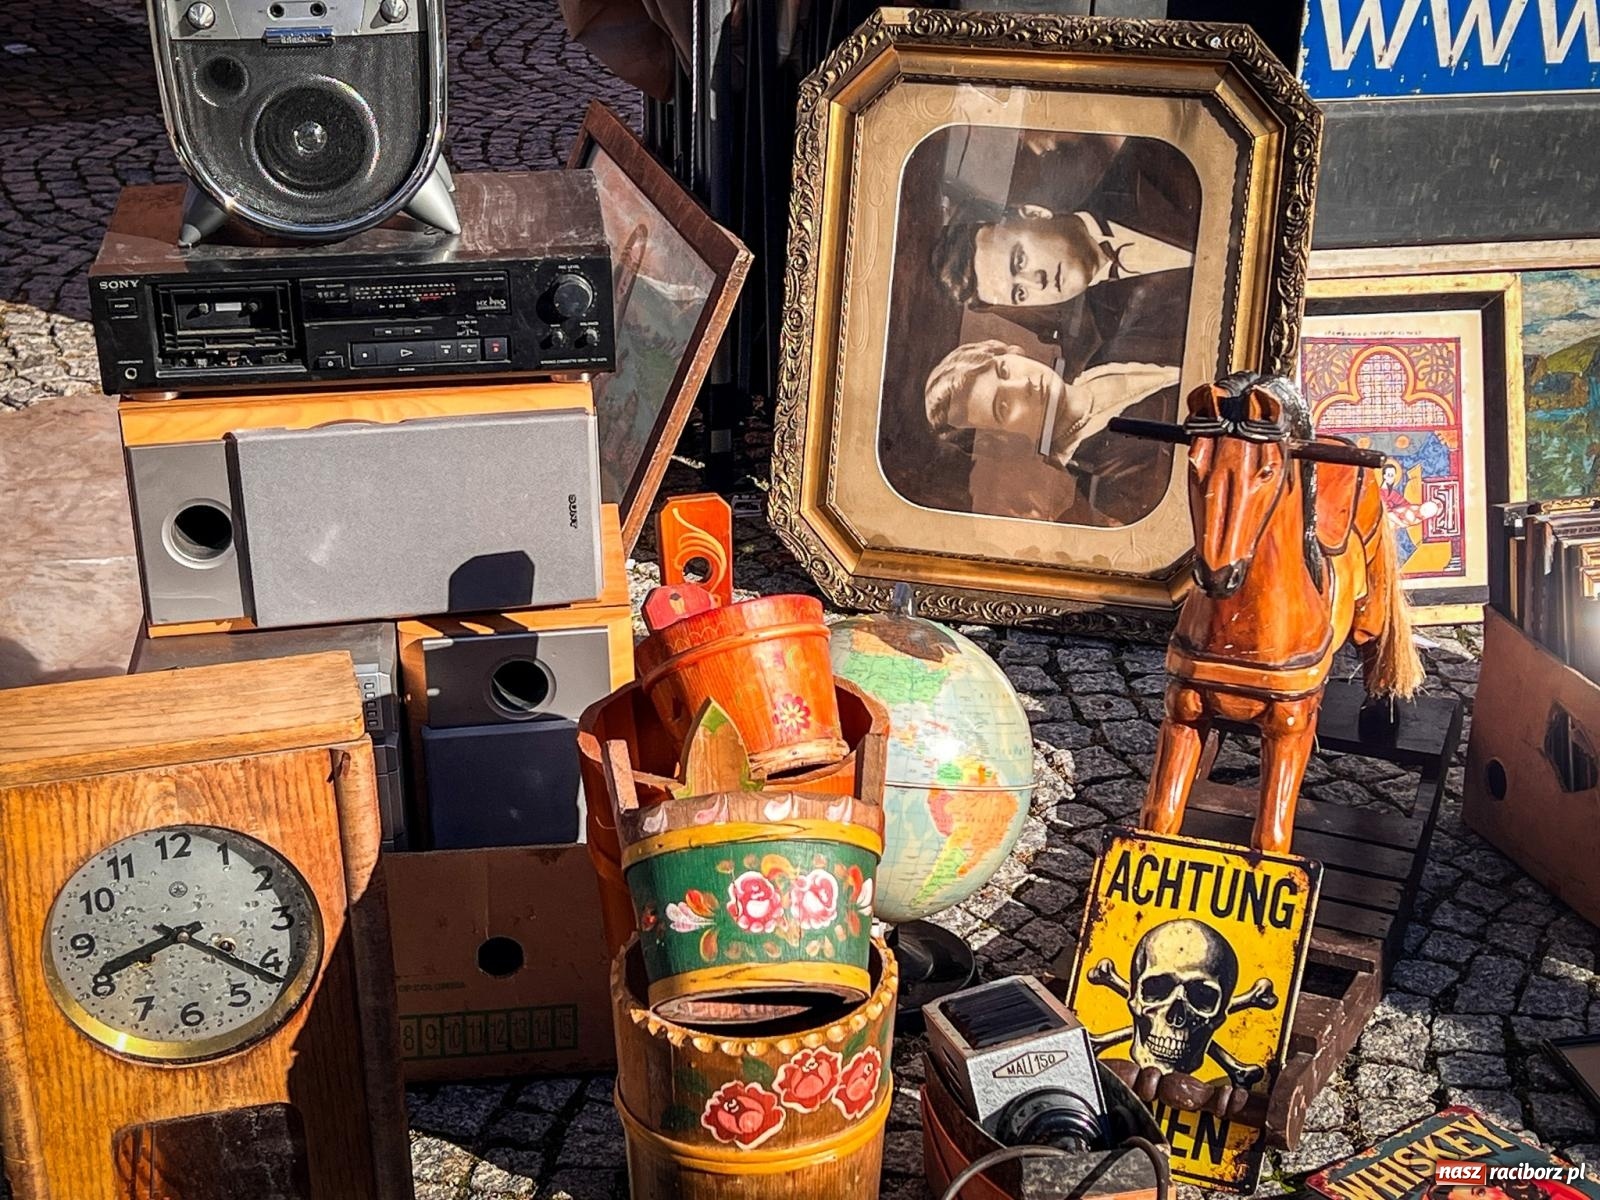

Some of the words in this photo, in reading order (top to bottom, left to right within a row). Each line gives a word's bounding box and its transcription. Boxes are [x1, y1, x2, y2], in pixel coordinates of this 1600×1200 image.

[99, 279, 140, 290] SONY
[155, 832, 191, 860] 12
[217, 840, 230, 865] 1
[107, 853, 134, 881] 11
[252, 865, 273, 892] 2
[79, 887, 115, 915] 10
[1105, 850, 1298, 930] ACHTUNG
[271, 905, 295, 931] 3
[70, 933, 96, 959] 9
[258, 949, 283, 973] 4
[91, 972, 117, 997] 8
[228, 982, 252, 1008] 5
[132, 995, 155, 1021] 7
[180, 1001, 205, 1027] 6
[403, 1024, 415, 1050] 8
[425, 1023, 437, 1049] 9
[445, 1022, 460, 1048] 10
[467, 1020, 483, 1048] 11
[488, 1019, 506, 1045] 12
[512, 1017, 527, 1043] 13
[534, 1015, 549, 1041] 14
[557, 1014, 571, 1040] 15
[1034, 1053, 1056, 1072] 150
[1330, 1113, 1520, 1200] WHISKEY
